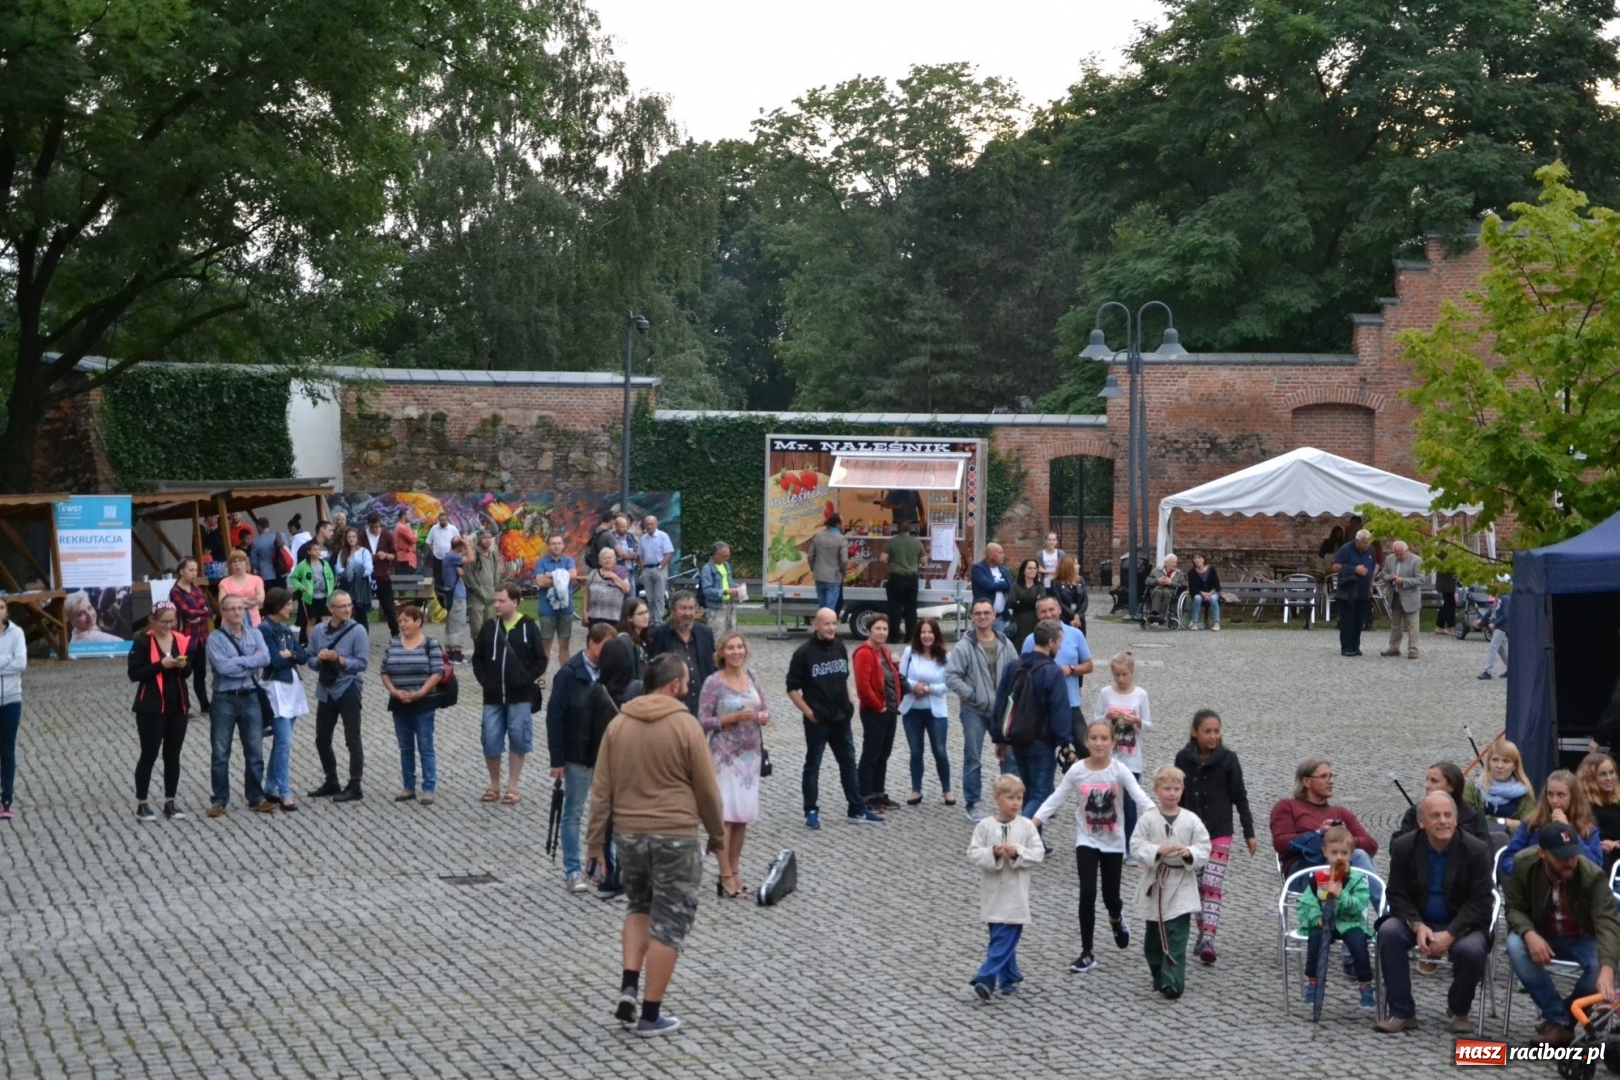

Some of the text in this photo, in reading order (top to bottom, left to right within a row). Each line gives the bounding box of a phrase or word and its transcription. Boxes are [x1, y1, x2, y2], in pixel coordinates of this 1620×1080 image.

[774, 440, 950, 452] Mr. NALEŚNIK
[59, 535, 123, 544] REKRUTACJA
